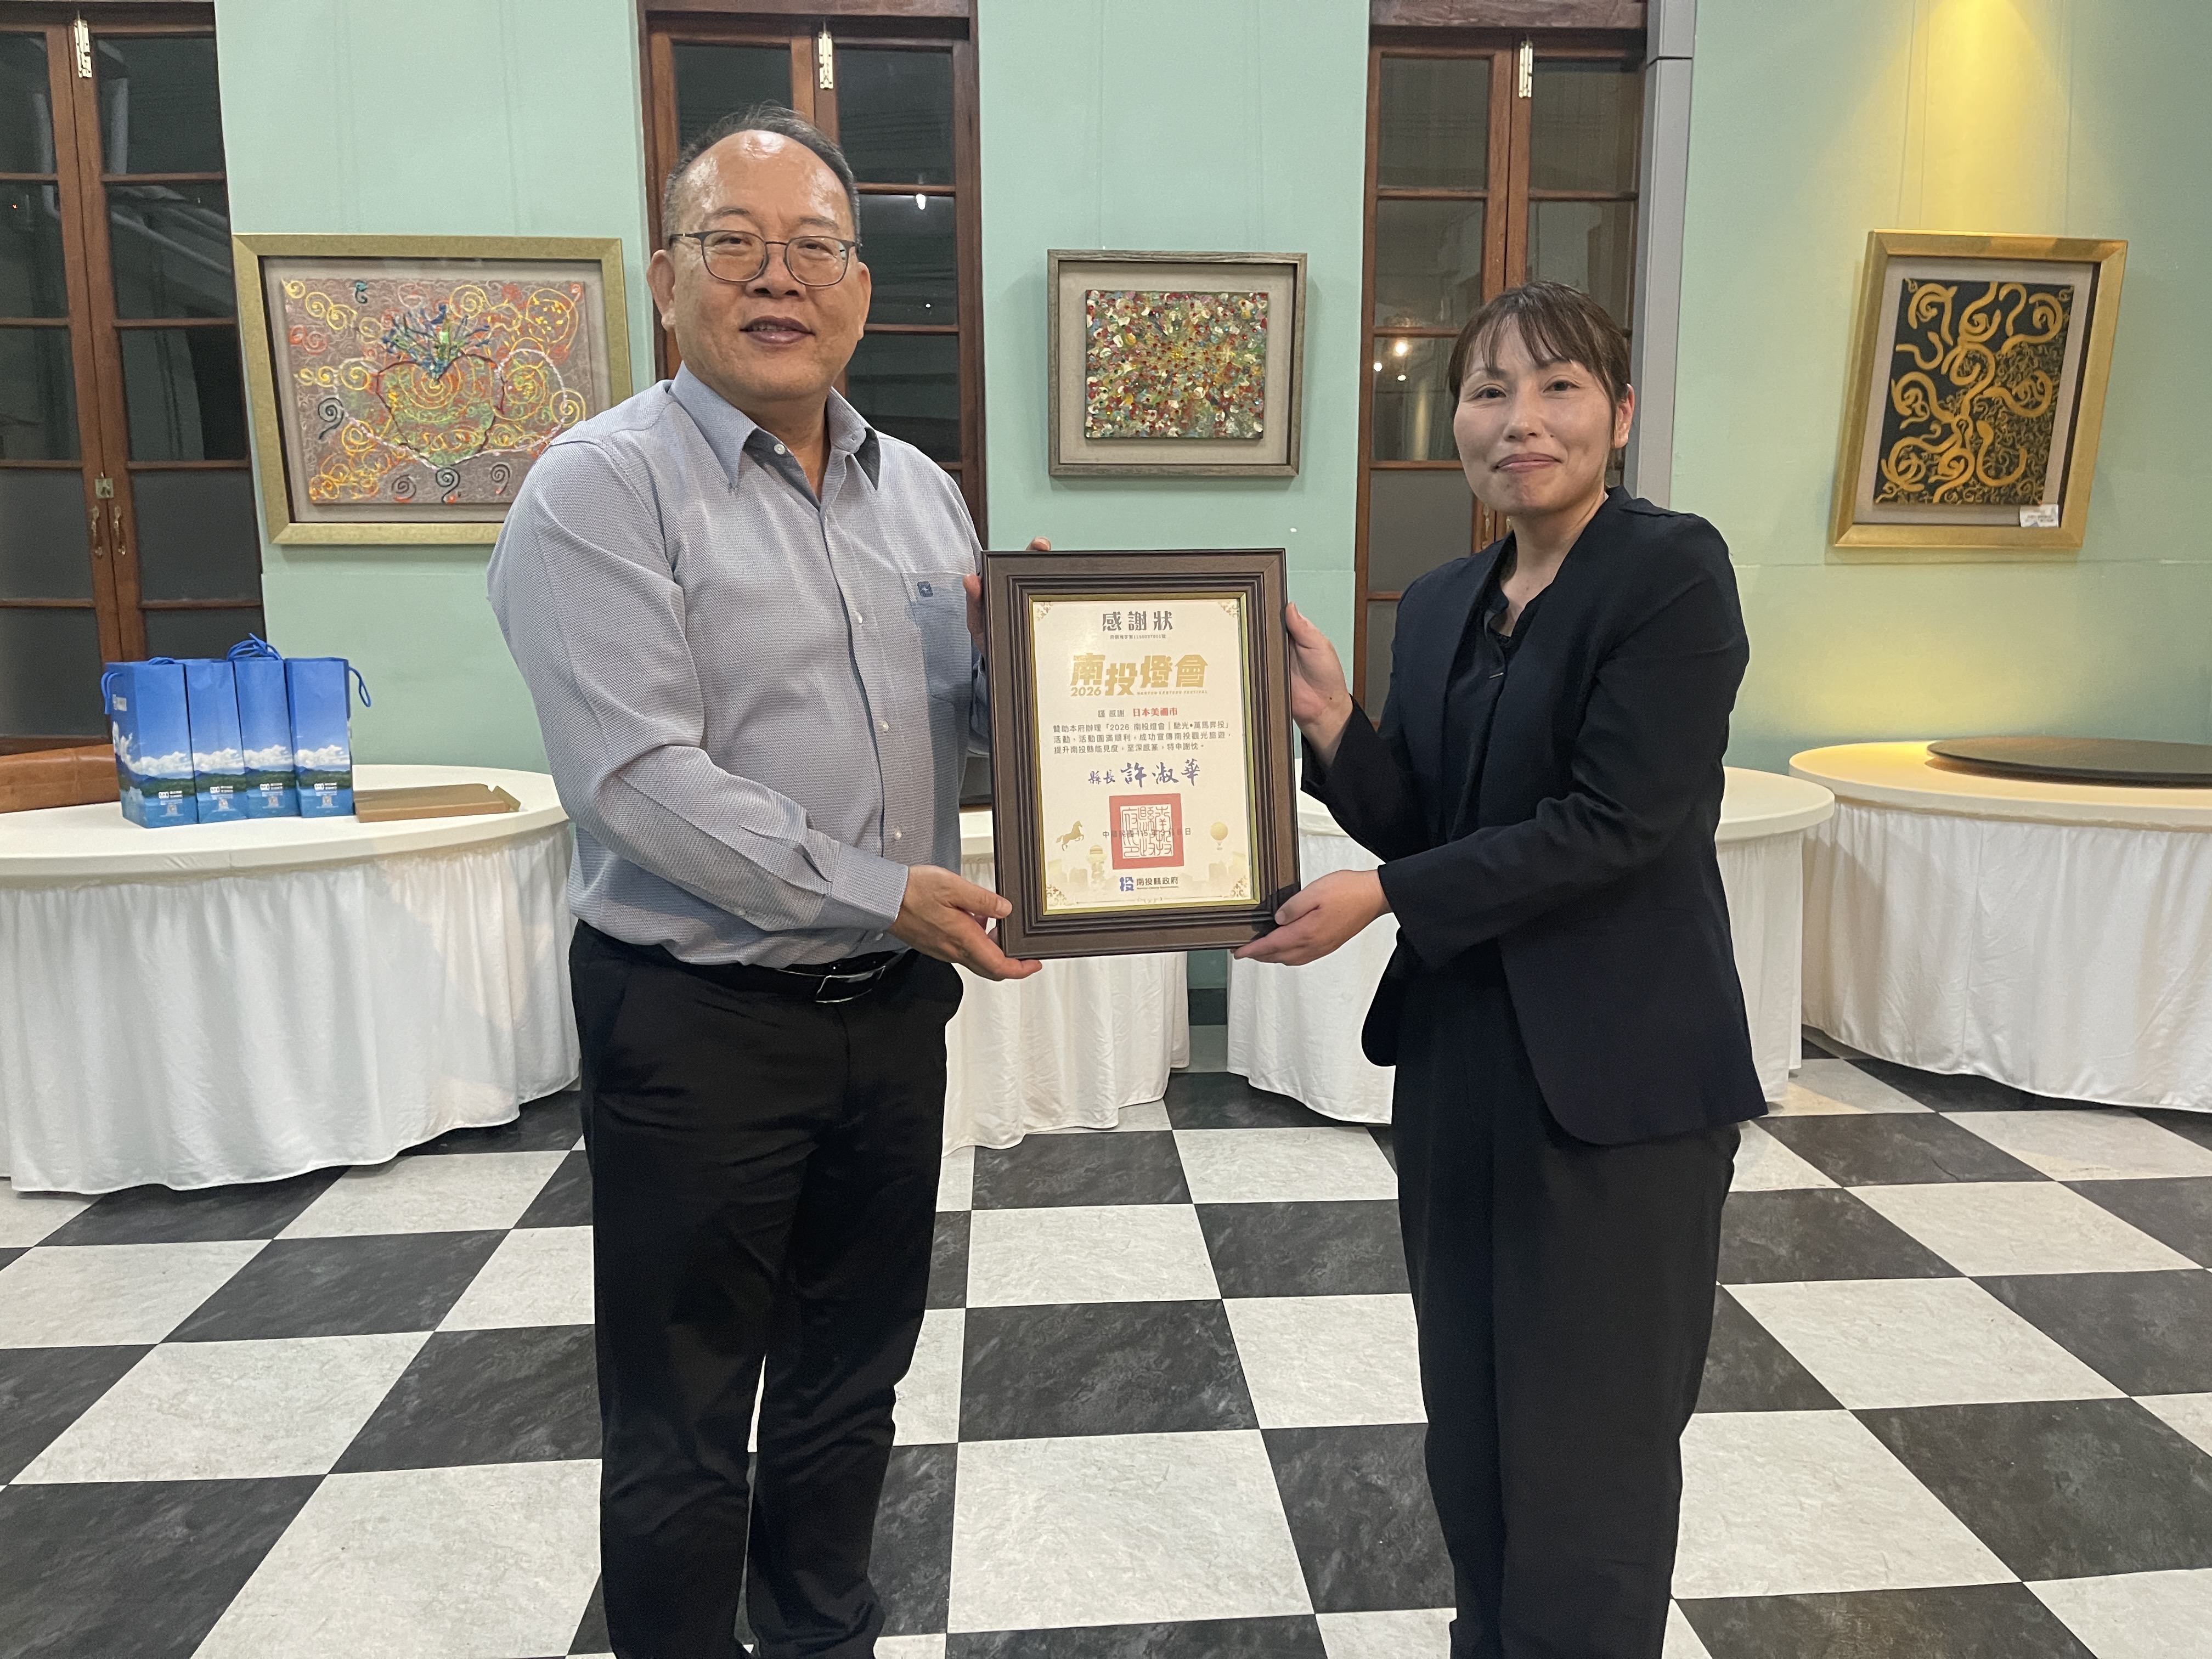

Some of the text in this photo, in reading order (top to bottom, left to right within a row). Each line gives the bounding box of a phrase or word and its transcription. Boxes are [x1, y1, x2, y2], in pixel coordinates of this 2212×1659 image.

[1102, 611, 1173, 631] 感謝狀
[1070, 653, 1209, 696] 南投燈會
[1070, 687, 1102, 696] 2026
[1088, 769, 1115, 785] 縣長
